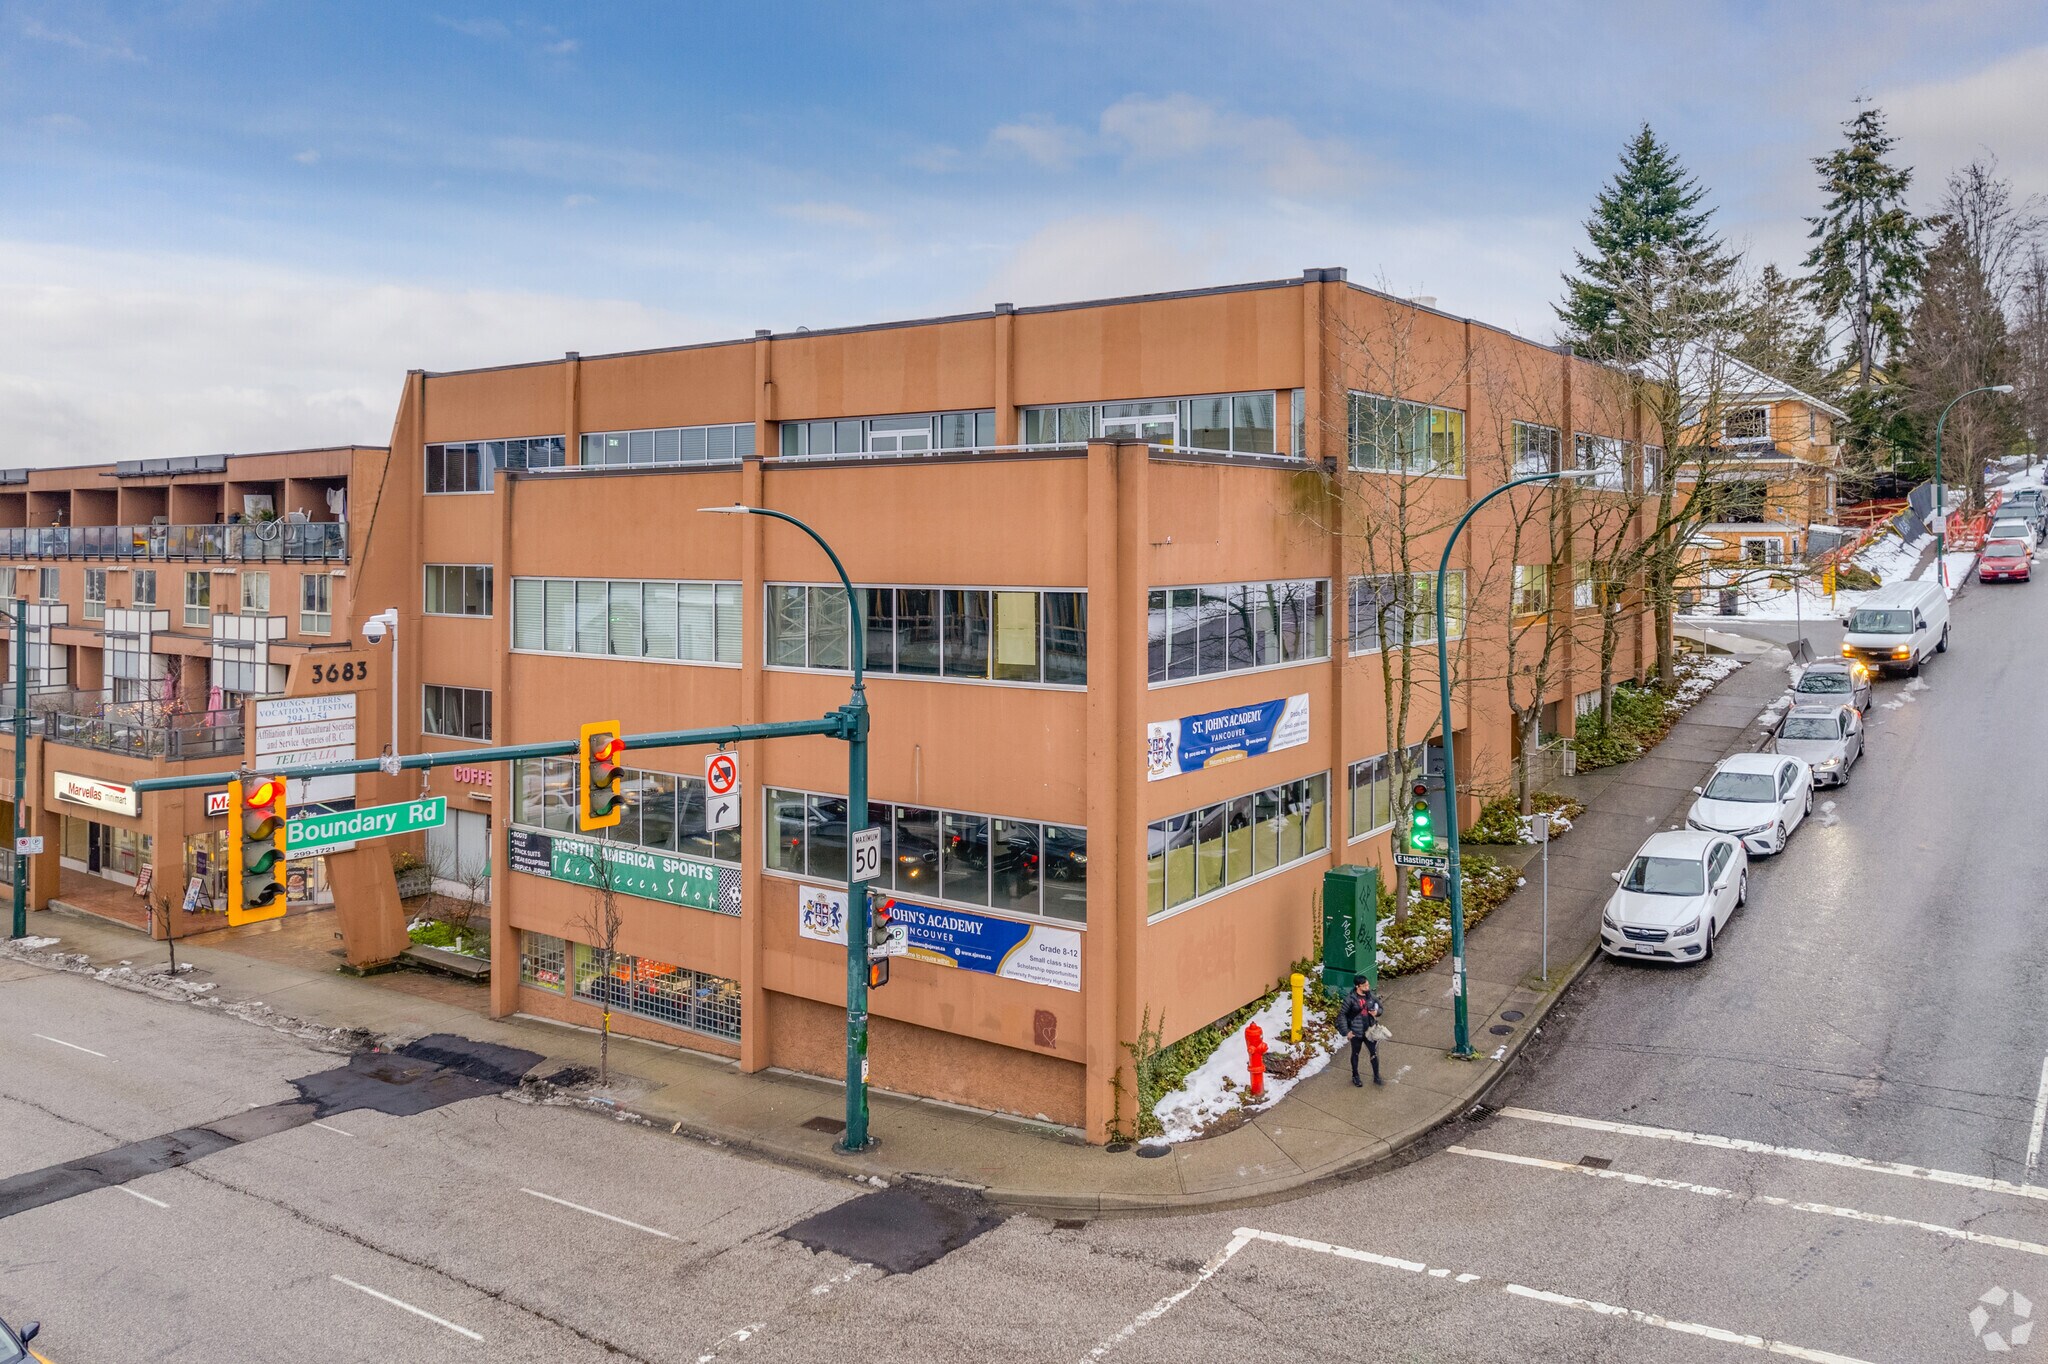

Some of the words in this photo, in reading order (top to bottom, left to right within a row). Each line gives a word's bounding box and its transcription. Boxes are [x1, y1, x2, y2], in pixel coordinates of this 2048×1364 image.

[312, 661, 367, 684] 3683
[260, 707, 316, 717] VOCATIONAL
[318, 703, 353, 712] TESTING
[287, 712, 327, 723] 294-1754
[257, 727, 286, 740] Affiliation
[286, 726, 294, 736] of
[295, 722, 331, 736] Multicultural
[331, 720, 354, 731] Societies
[1192, 722, 1203, 734] ST.
[1205, 717, 1229, 735] JOHN'S
[1229, 709, 1262, 727] ACADEMY
[267, 740, 278, 750] and
[278, 738, 299, 749] Service
[301, 735, 325, 747] Agencies
[325, 734, 332, 744] of
[1211, 728, 1246, 742] VANCOUVER
[68, 782, 102, 801] Marvellas
[288, 812, 397, 844] Boundary
[409, 801, 437, 824] Rd
[855, 833, 879, 844] MAXIMUM
[294, 846, 336, 858] 299-1721
[555, 838, 594, 858] NORTH
[601, 848, 655, 869] AMERICA
[662, 859, 713, 881] SPORTS
[856, 846, 877, 873] 50
[1404, 856, 1434, 866] Hastings
[552, 855, 580, 876] The
[667, 878, 716, 909] Shop
[888, 907, 925, 925] JOHN'S
[927, 914, 983, 935] ACADEMY
[1040, 943, 1061, 954] Grade
[1062, 947, 1078, 957] 8-12
[1017, 962, 1045, 973] Scholarship
[1046, 968, 1078, 979] opportunities
[1029, 955, 1045, 963] Small
[1047, 958, 1062, 967] class
[1063, 961, 1078, 970] sizes
[1006, 969, 1027, 978] University
[1028, 973, 1052, 983] Preparatory
[1063, 980, 1079, 988] School
